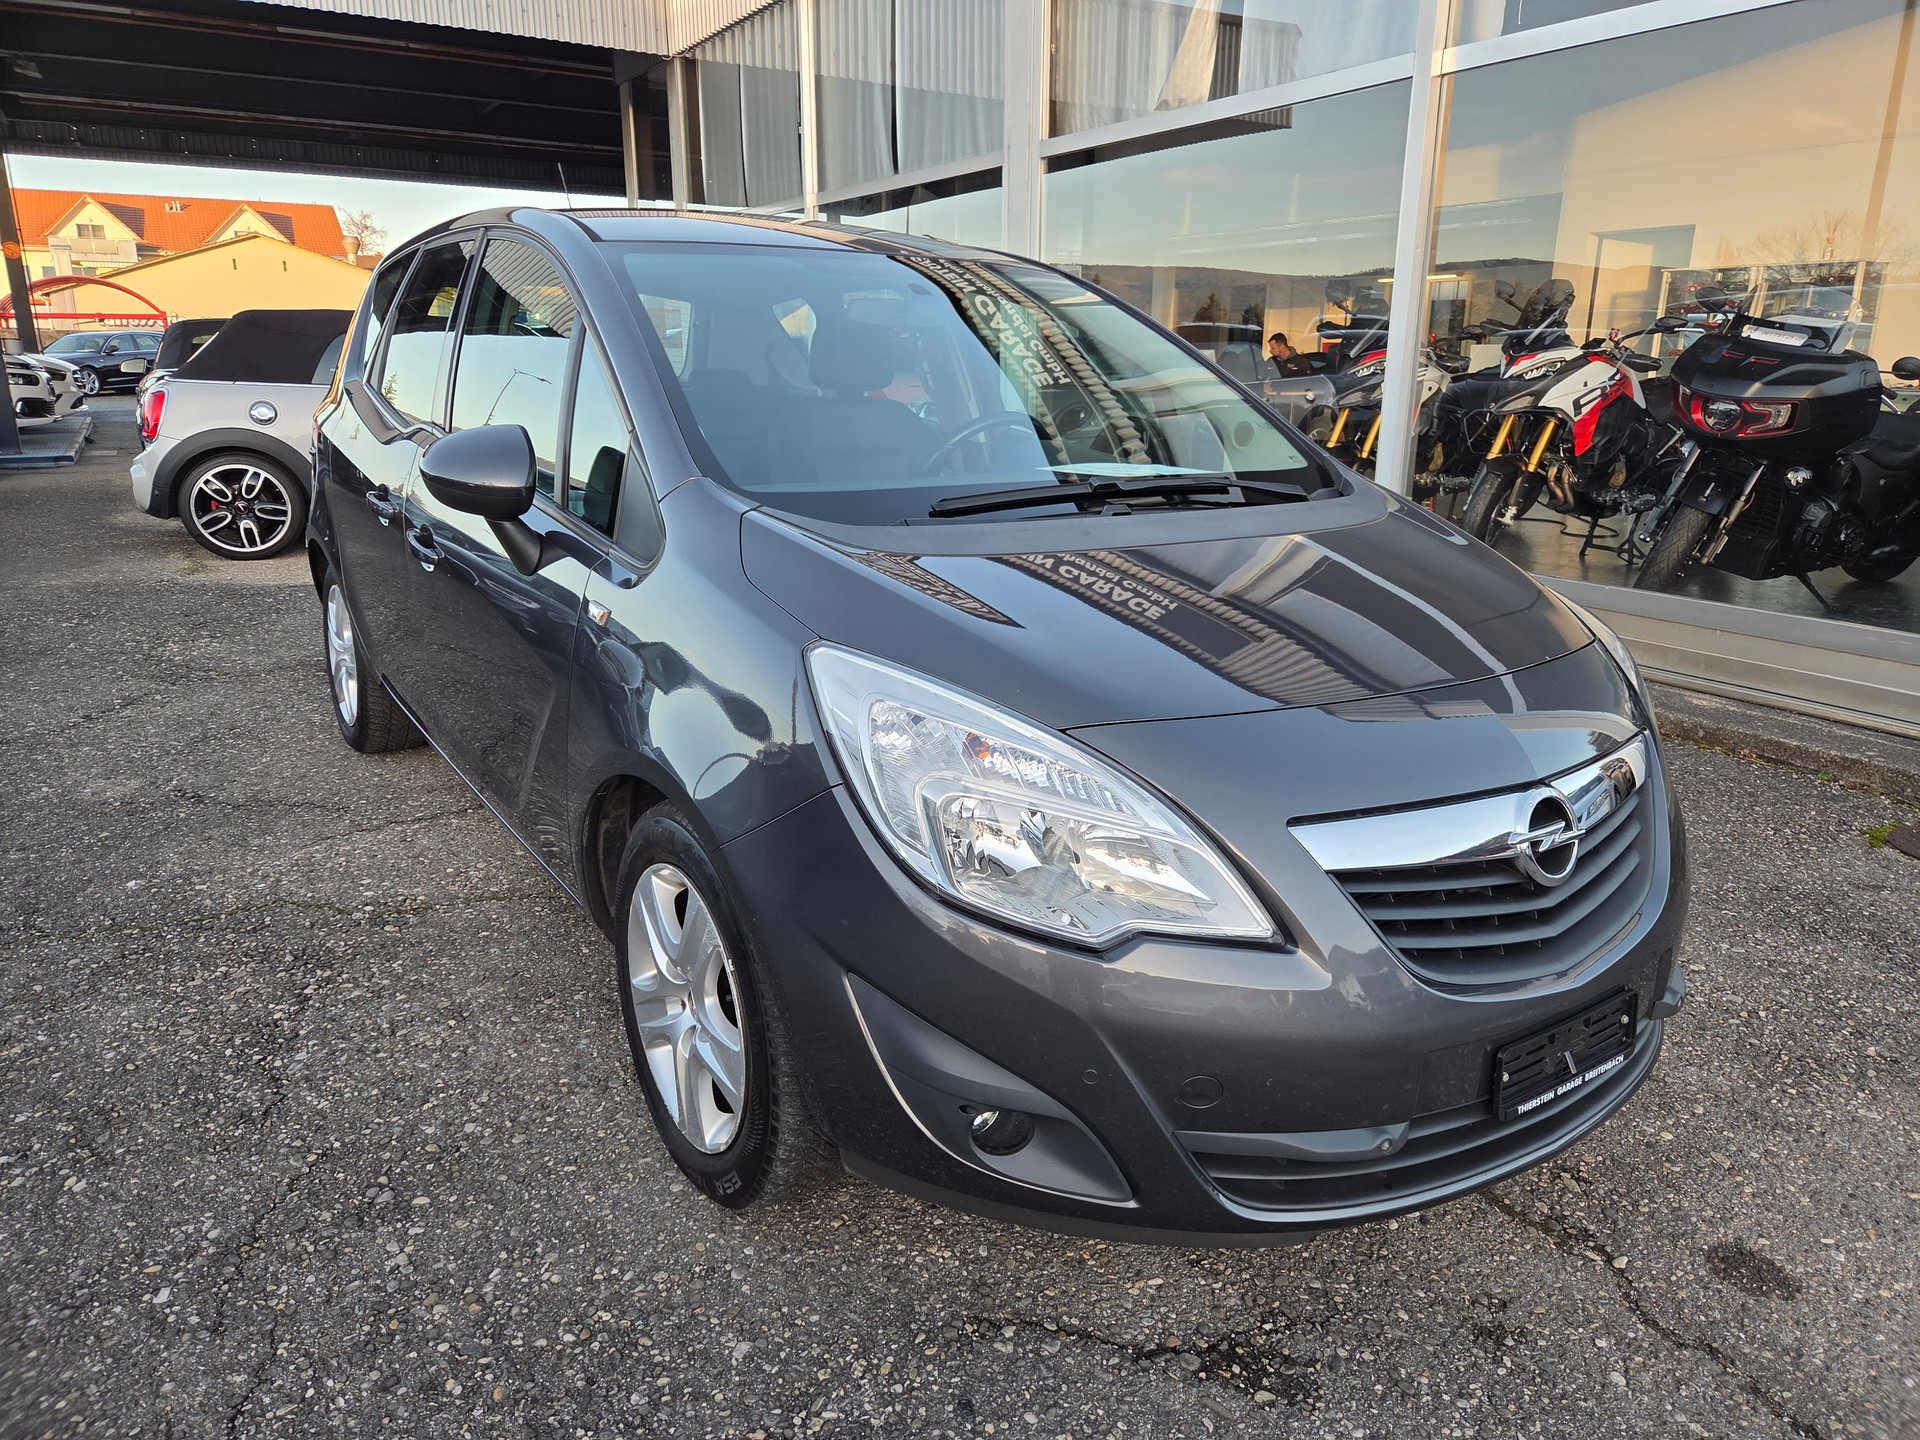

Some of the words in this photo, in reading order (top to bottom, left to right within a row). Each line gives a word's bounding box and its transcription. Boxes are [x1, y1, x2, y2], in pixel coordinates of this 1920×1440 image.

[1517, 1090, 1555, 1115] THIERSTEIN
[1557, 1076, 1583, 1096] GARAGE
[1584, 1054, 1624, 1082] BREITENBACH
